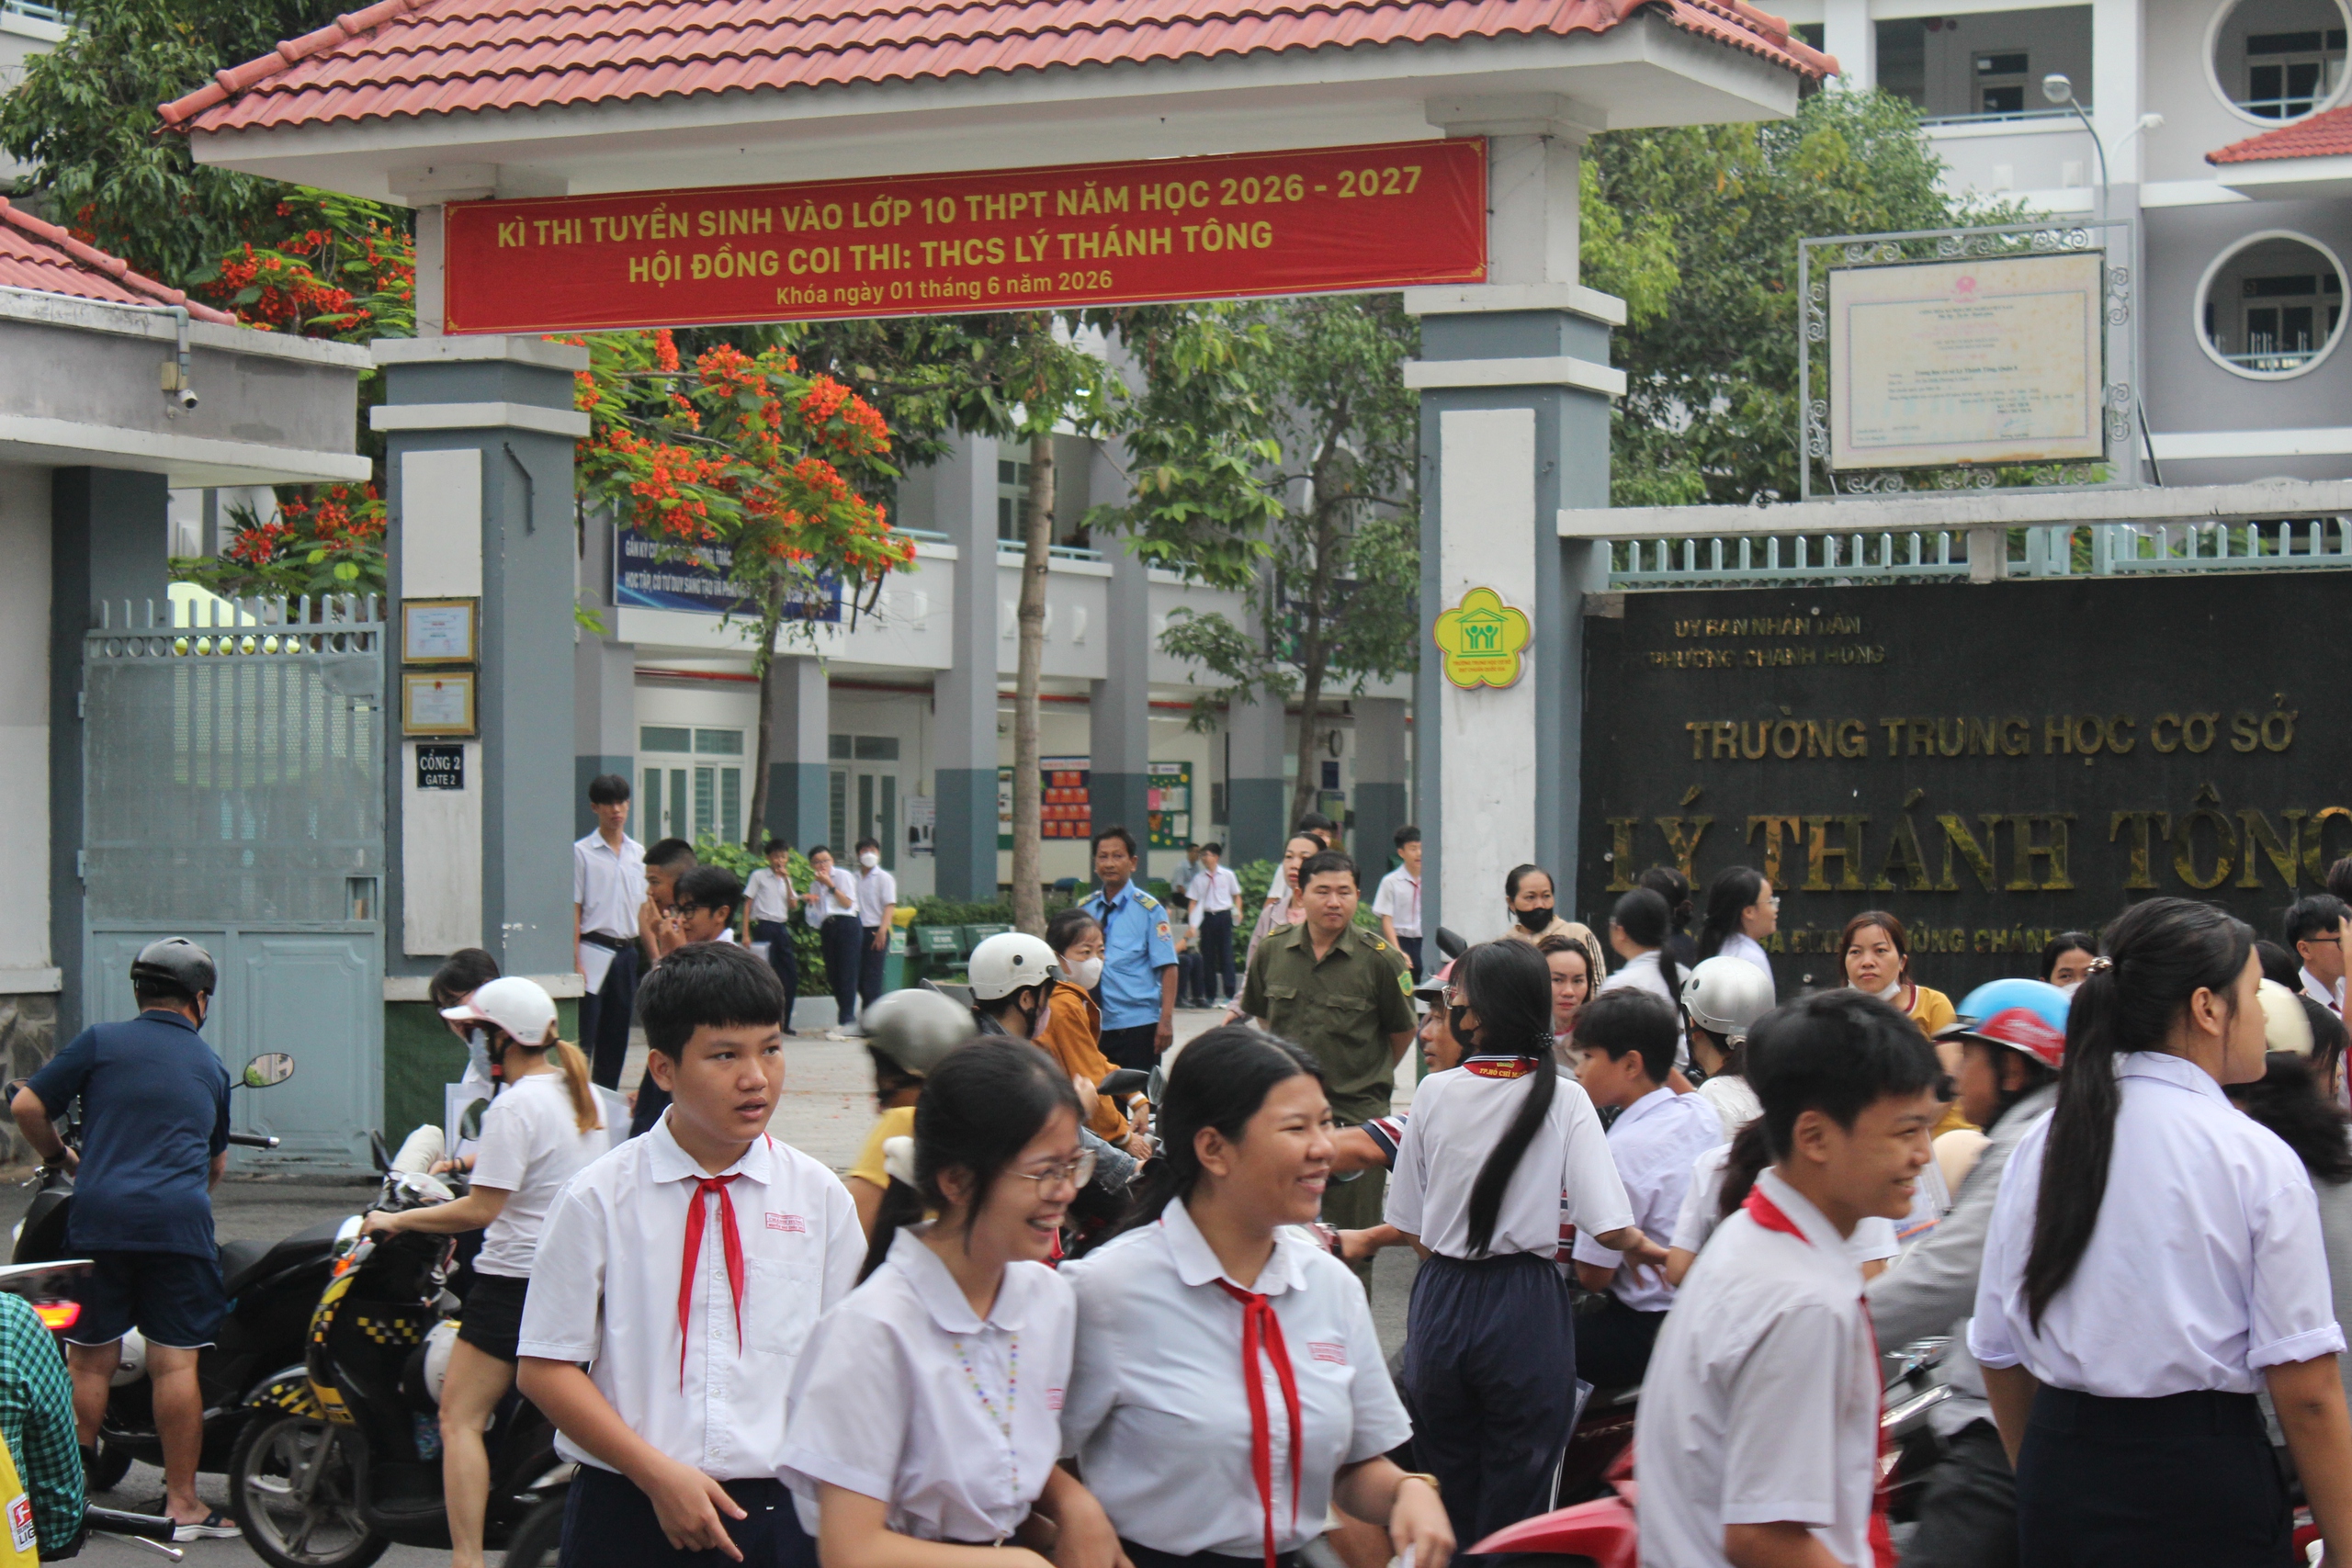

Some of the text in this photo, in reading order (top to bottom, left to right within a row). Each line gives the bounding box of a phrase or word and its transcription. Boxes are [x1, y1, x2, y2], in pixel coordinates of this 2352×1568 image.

[498, 214, 526, 248] KÌ
[534, 219, 582, 245] THI
[590, 201, 688, 243] TUYỂN
[697, 208, 772, 237] SINH
[781, 199, 843, 231] VÀO
[854, 196, 912, 228] LỚP
[921, 196, 956, 225] 10
[964, 190, 1047, 221] THPT
[1057, 182, 1129, 216] NĂM
[1140, 180, 1210, 216] HỌC
[1219, 174, 1305, 207] 2026
[1338, 165, 1423, 198] 2027
[628, 217, 1273, 288] HỘI ĐỒNG COI THI: THCS LÝ THÁNH TÔNG
[775, 269, 1113, 306] Khóa ngày 01 tháng 6 năm 2026
[1706, 618, 1748, 636] BAN
[1751, 613, 1811, 635] NHÂN
[1685, 692, 2299, 766] TRƯỜNG TRUNG HỌC CƠ SỞ
[420, 750, 461, 771] CỔNG 2
[425, 774, 456, 785] GATE 2
[1605, 784, 1715, 892] LÝ
[1746, 786, 2078, 892] THÁNH
